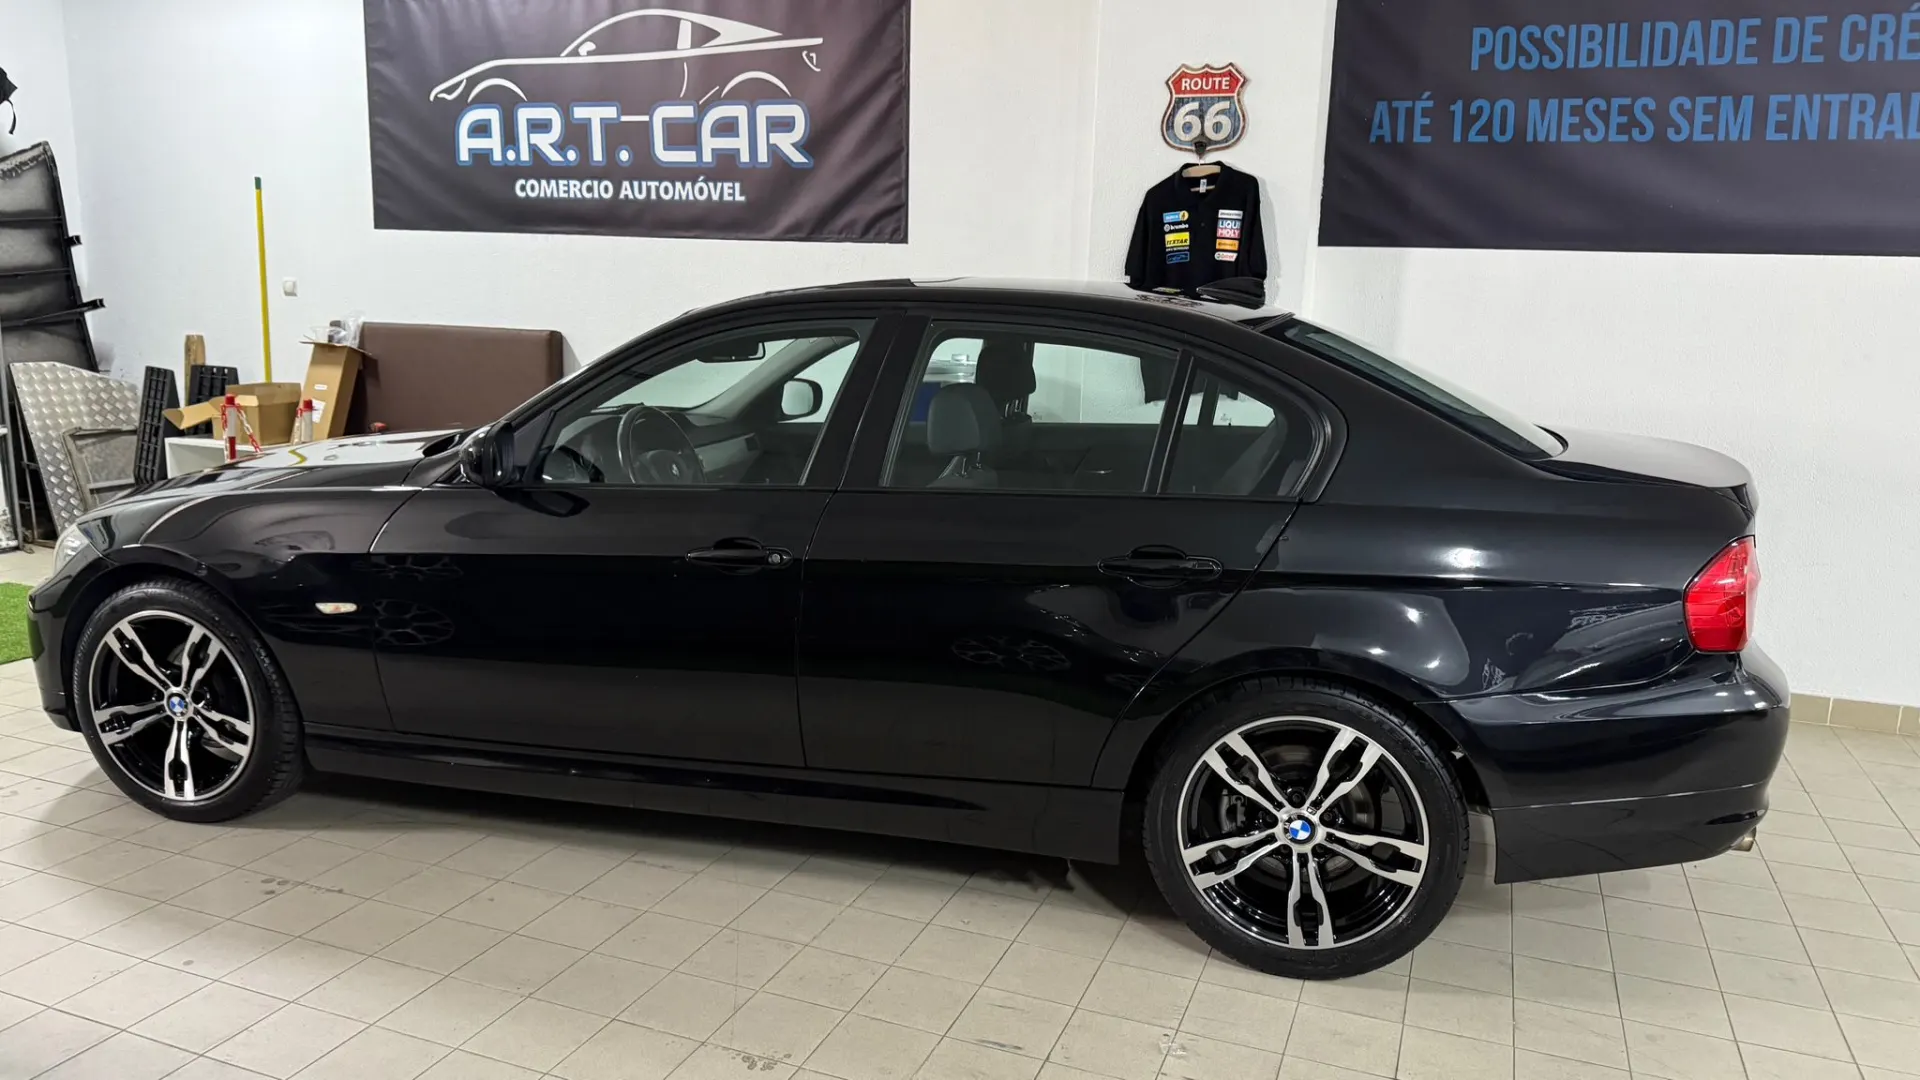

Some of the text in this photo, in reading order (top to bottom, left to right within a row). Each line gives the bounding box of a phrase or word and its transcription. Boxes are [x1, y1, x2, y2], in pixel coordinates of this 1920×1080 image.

[1471, 2, 1920, 71] POSSIBILIDADE DE CRÉ
[1181, 77, 1231, 91] ROUTE
[1173, 101, 1232, 142] 66
[1369, 92, 1435, 143] ATÉ
[1450, 99, 1516, 143] 120
[1526, 97, 1656, 143] MESES
[1667, 96, 1755, 142] SEM
[514, 175, 746, 202] COMERCIO AUTOMÓVEL
[1217, 228, 1240, 238] MOLY
